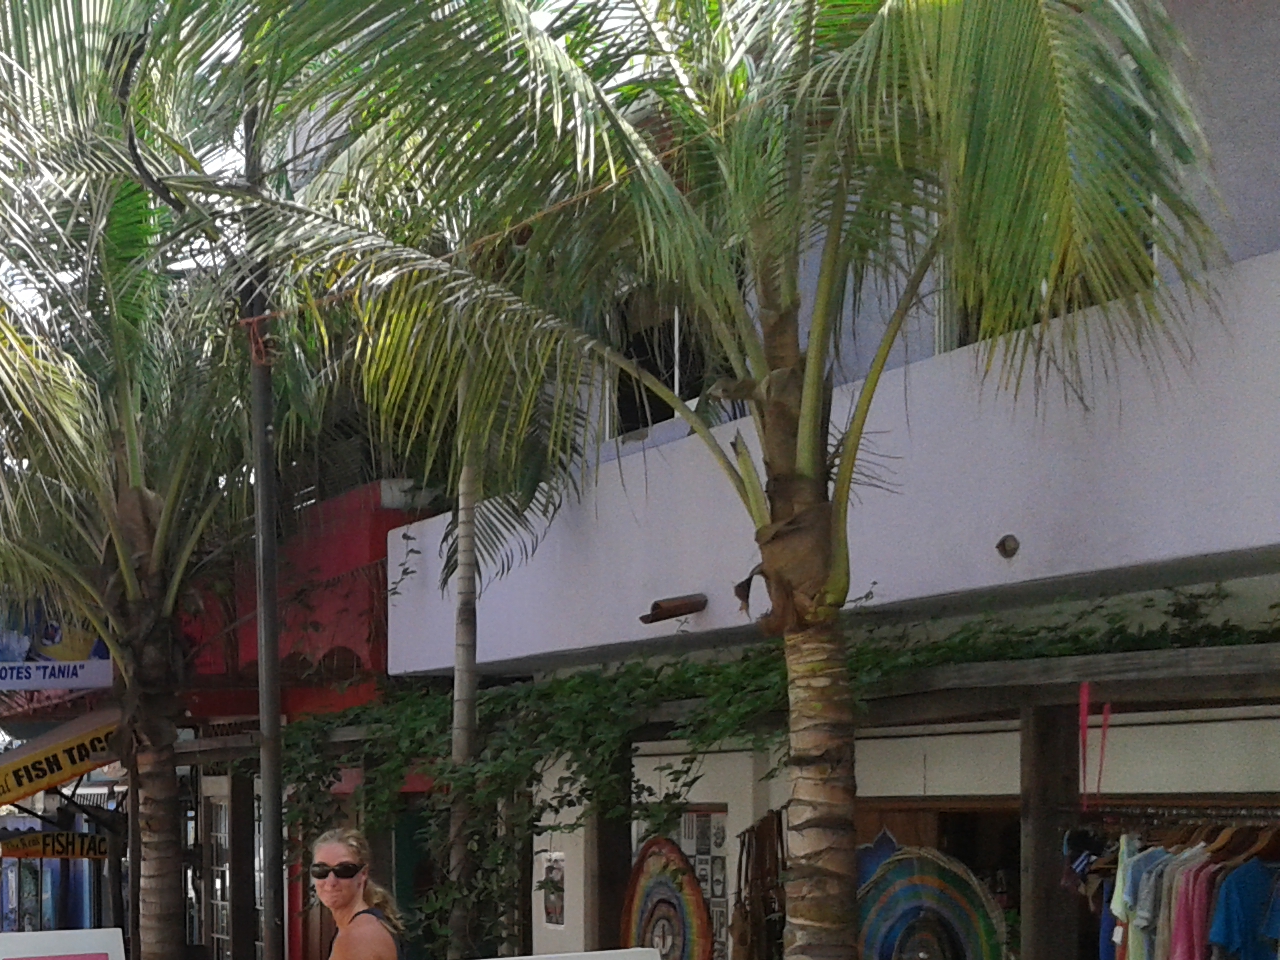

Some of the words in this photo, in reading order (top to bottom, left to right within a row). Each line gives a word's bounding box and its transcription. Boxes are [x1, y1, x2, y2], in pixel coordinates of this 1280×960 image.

[35, 664, 85, 680] "TANIA"
[12, 753, 63, 787] FISH
[42, 832, 75, 856] FISH
